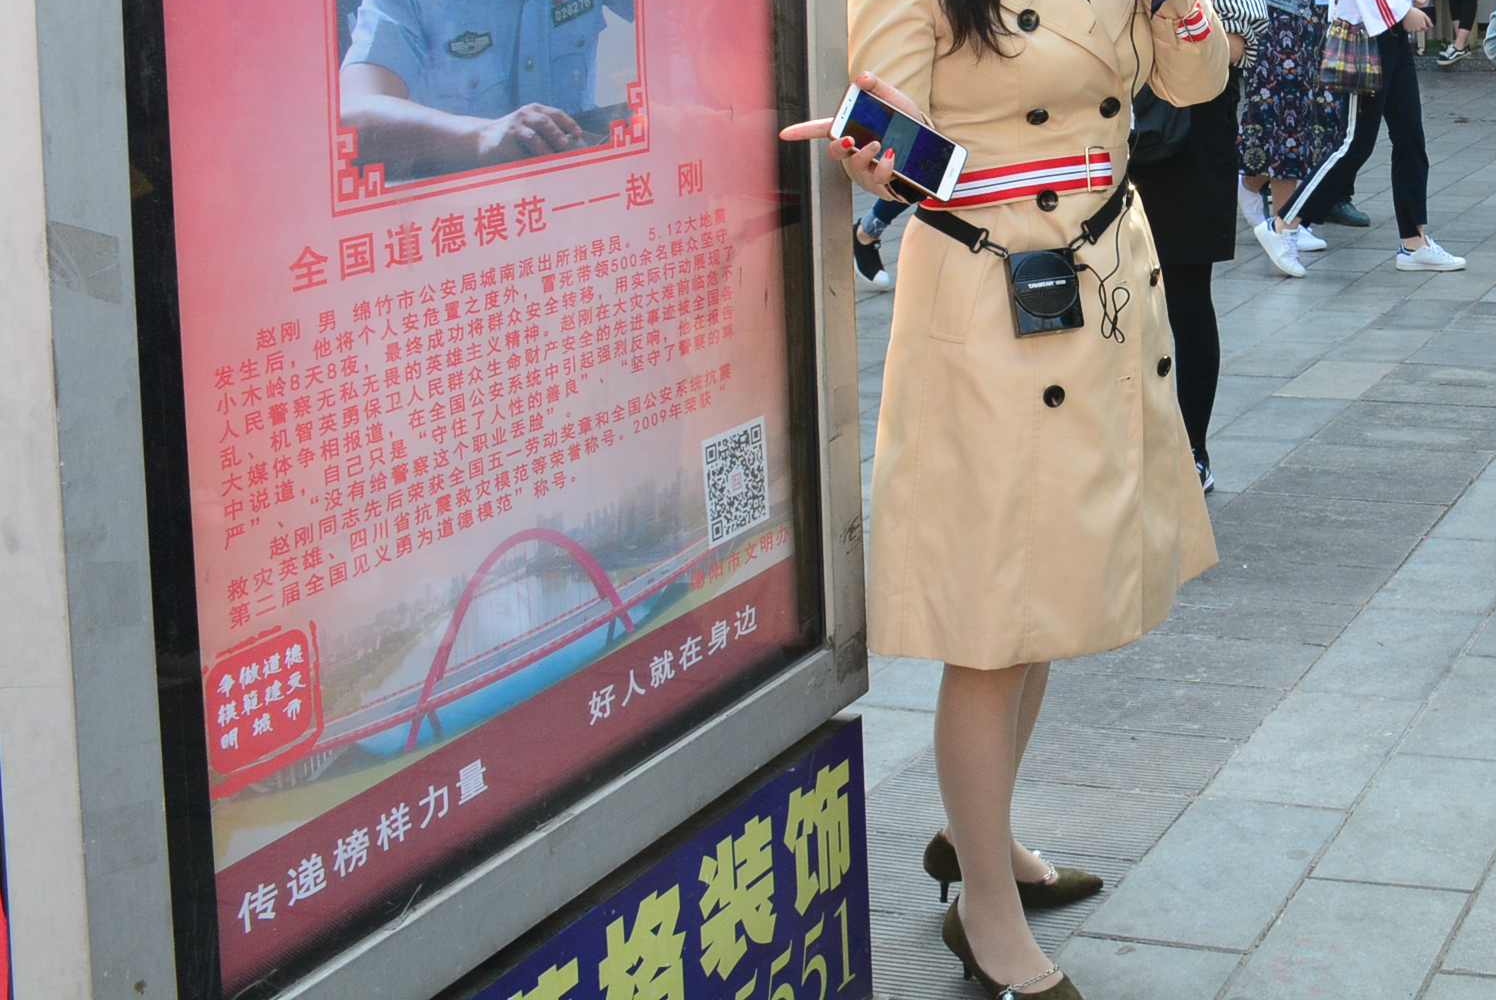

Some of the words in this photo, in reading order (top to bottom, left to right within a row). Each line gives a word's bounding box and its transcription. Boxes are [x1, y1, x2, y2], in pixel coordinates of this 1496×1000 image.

[588, 604, 758, 726] 好人就在身边
[237, 758, 488, 934] 传递榜样力量
[508, 758, 851, 1000] 格装饰
